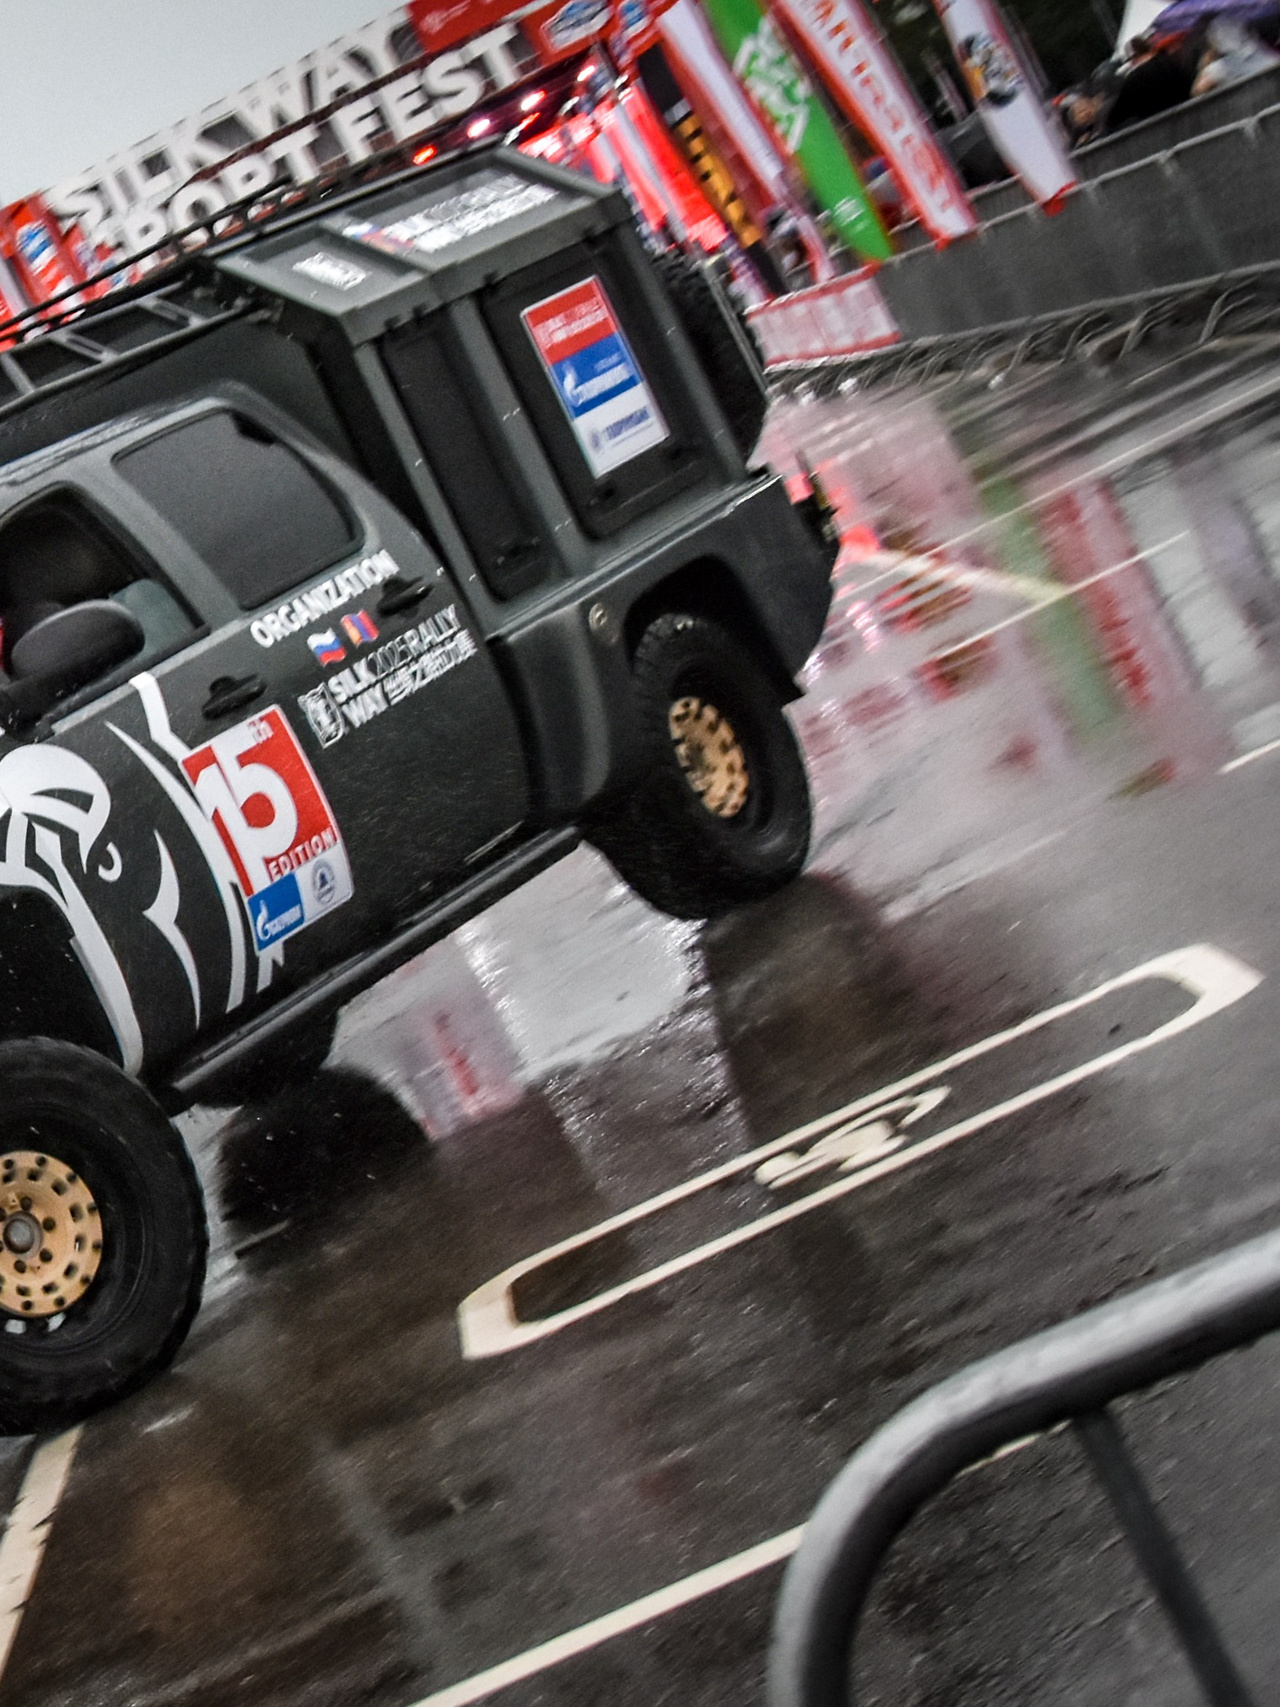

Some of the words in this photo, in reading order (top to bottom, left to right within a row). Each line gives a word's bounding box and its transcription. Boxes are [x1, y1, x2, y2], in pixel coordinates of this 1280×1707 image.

[43, 110, 228, 224] SILK
[232, 5, 410, 136] WAY
[331, 24, 520, 167] FEST
[250, 549, 400, 648] ORGANIZATION
[327, 657, 381, 703] SILK
[367, 631, 413, 678] 2025
[404, 603, 462, 658] RALLY
[340, 683, 389, 729] WAY
[270, 826, 339, 881] EDITION
